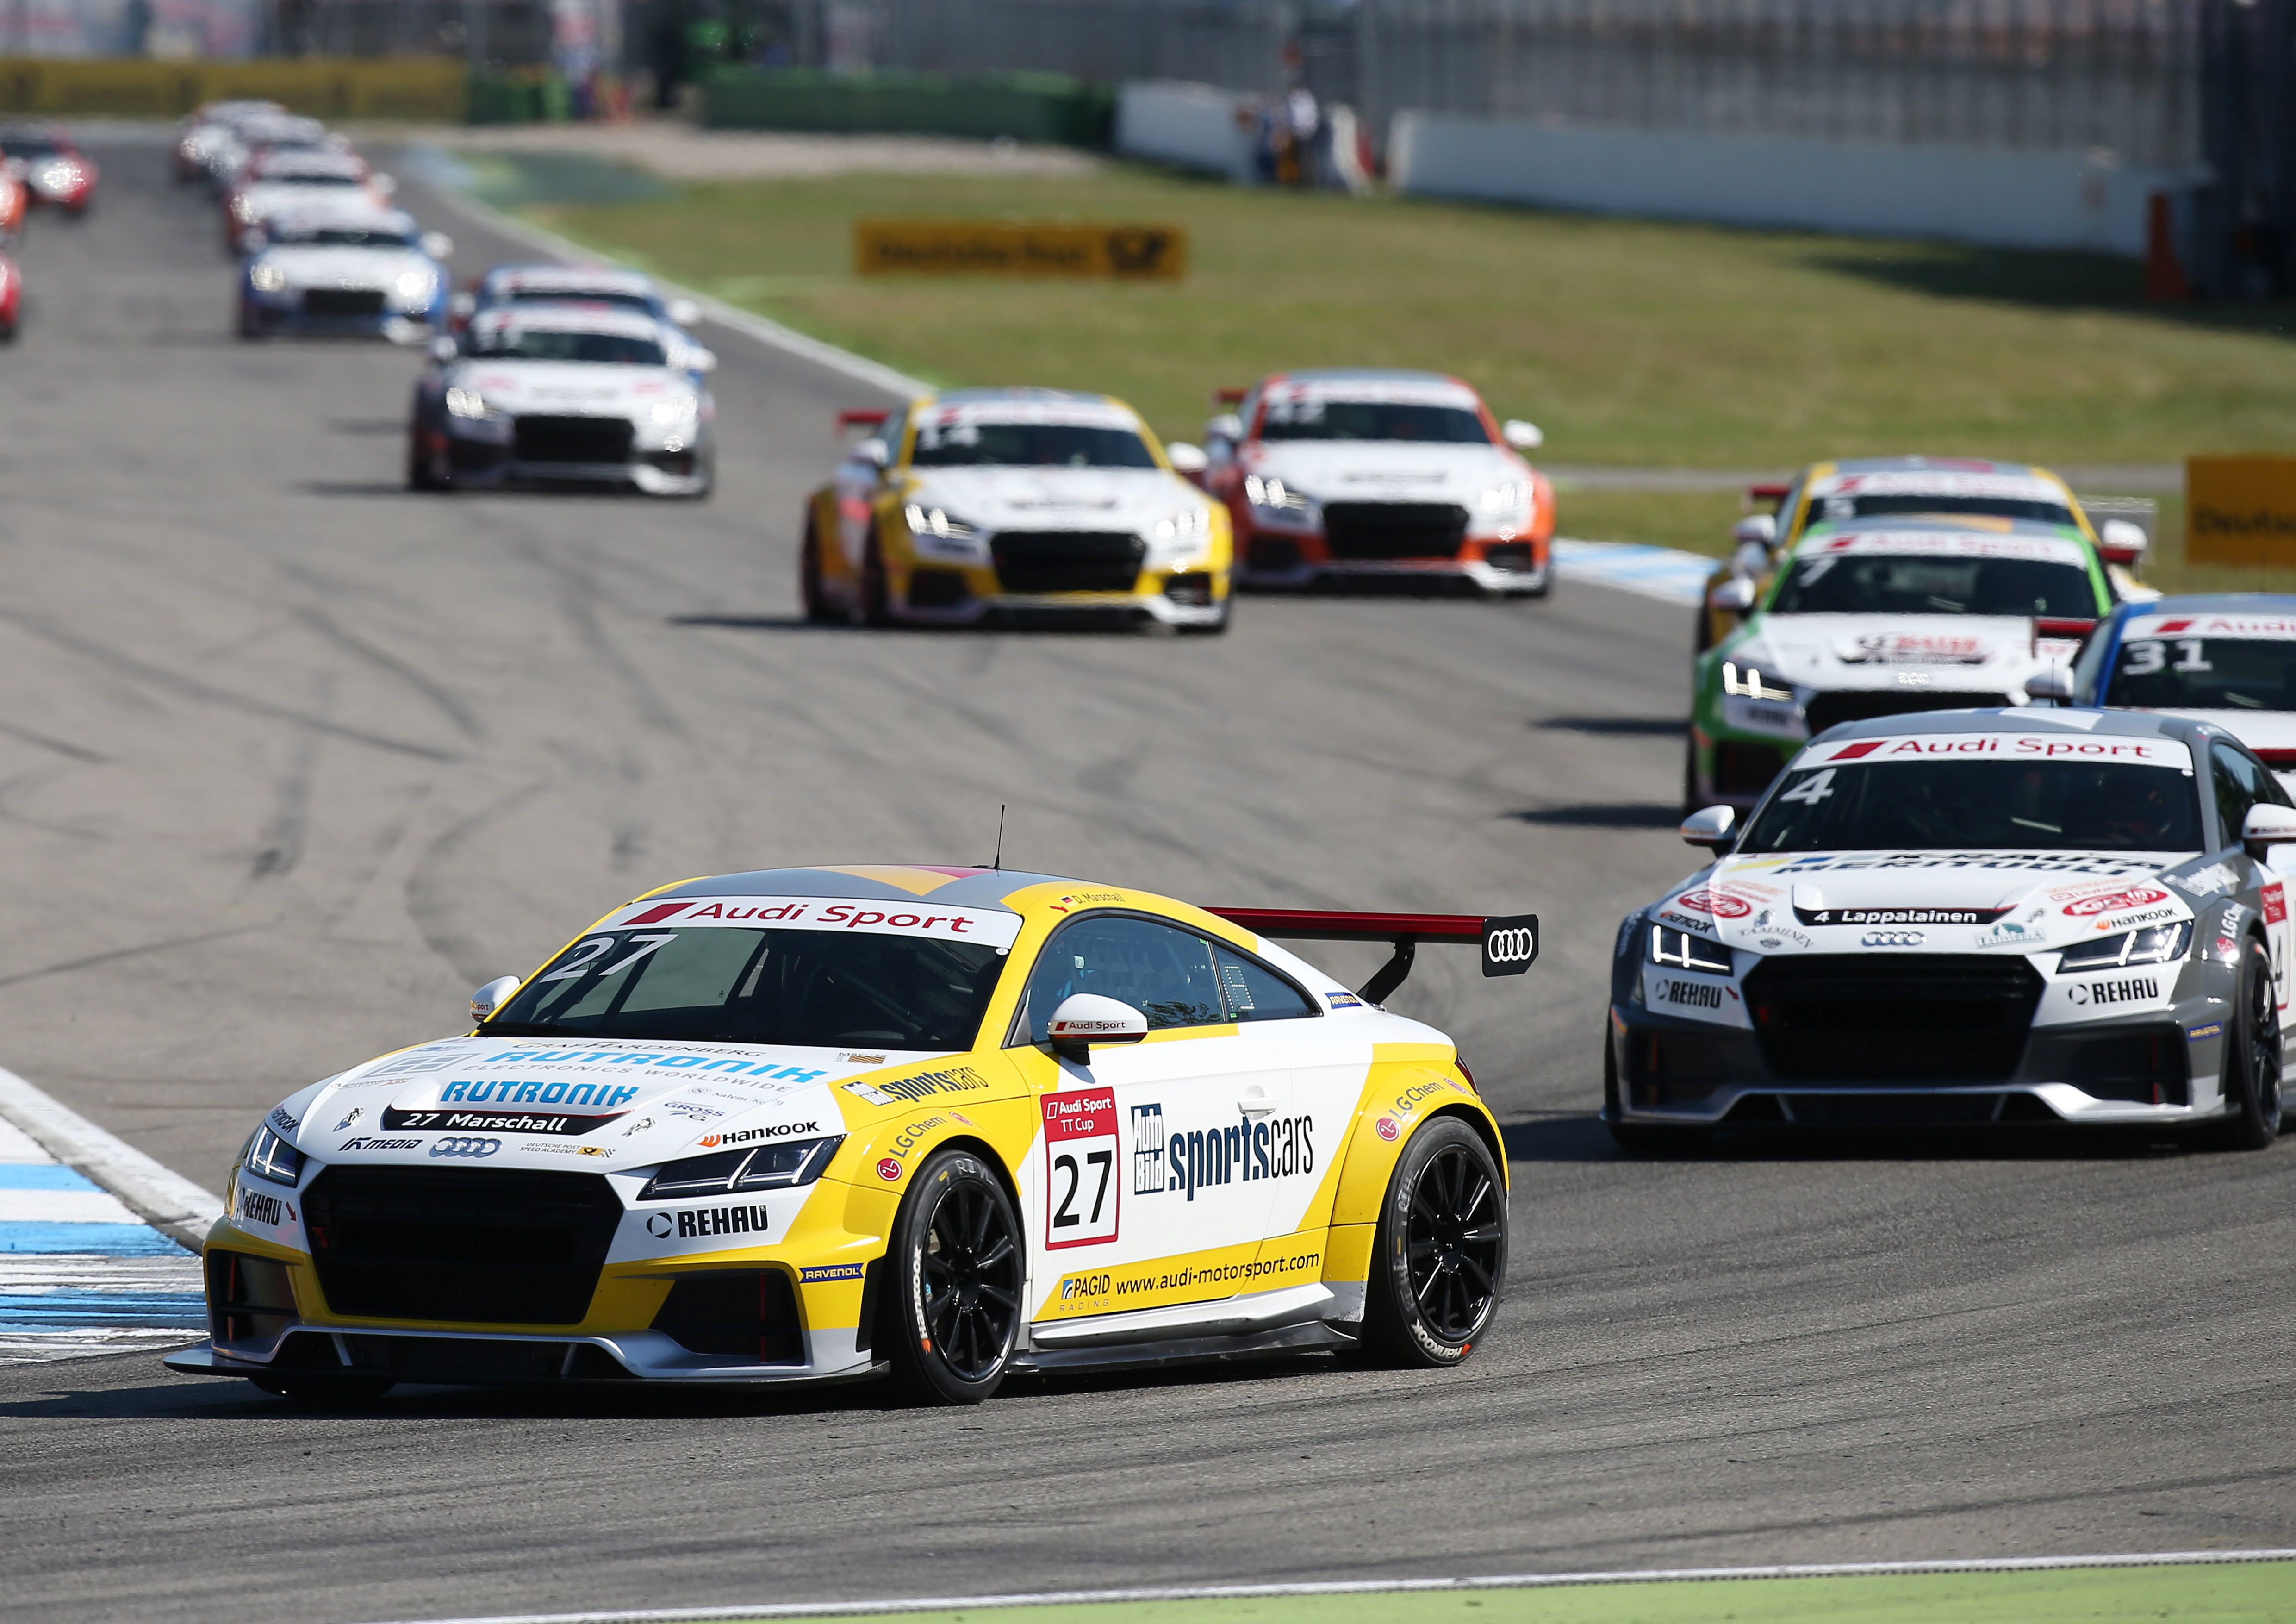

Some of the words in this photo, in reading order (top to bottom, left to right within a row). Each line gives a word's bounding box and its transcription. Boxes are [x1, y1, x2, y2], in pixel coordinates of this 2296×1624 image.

[1798, 555, 1839, 588] 7
[2207, 617, 2296, 632] Audi
[2122, 639, 2213, 675] 31
[1889, 737, 2000, 756] Audi
[2015, 738, 2153, 759] Sport
[1780, 768, 1837, 806] 4
[1082, 892, 1126, 903] Marschall
[685, 902, 810, 921] Audi
[816, 905, 975, 933] Sport
[1814, 911, 1830, 922] 4
[1841, 909, 1977, 924] Lappalainen
[2220, 918, 2239, 940] LG
[539, 934, 679, 983] 27
[1668, 981, 1723, 1009] REHAU
[2092, 978, 2159, 1005] REHAU
[1096, 1021, 1126, 1031] Sport
[462, 1065, 633, 1074] ELECTRONICS
[643, 1068, 794, 1093] WORLDWIDE
[483, 1051, 828, 1083] RUTRONIK
[439, 1081, 640, 1107] RUTRONIK
[1059, 1099, 1082, 1114] Audi
[1083, 1097, 1112, 1115] Sport
[1388, 1093, 1413, 1120] LG
[1404, 1081, 1444, 1103] Chem
[401, 1113, 440, 1126] 27
[445, 1113, 568, 1131] Marschall
[664, 1102, 725, 1117] GROSS
[889, 1135, 915, 1158] LG
[905, 1115, 947, 1138] Chem
[1060, 1120, 1074, 1132] TT
[1074, 1117, 1095, 1134] Cup
[1134, 1107, 1163, 1153] Auto
[1135, 1151, 1164, 1192] Bild
[1169, 1115, 1313, 1202] sportscars
[1053, 1150, 1113, 1228] 27
[245, 1190, 283, 1226] REHAU
[678, 1205, 768, 1238] REHAU
[804, 1267, 862, 1280] RAVENOL
[1073, 1274, 1111, 1298] PAGID
[1116, 1252, 1319, 1296] www.audi-motorsport.com
[1059, 1298, 1110, 1313] RACING
